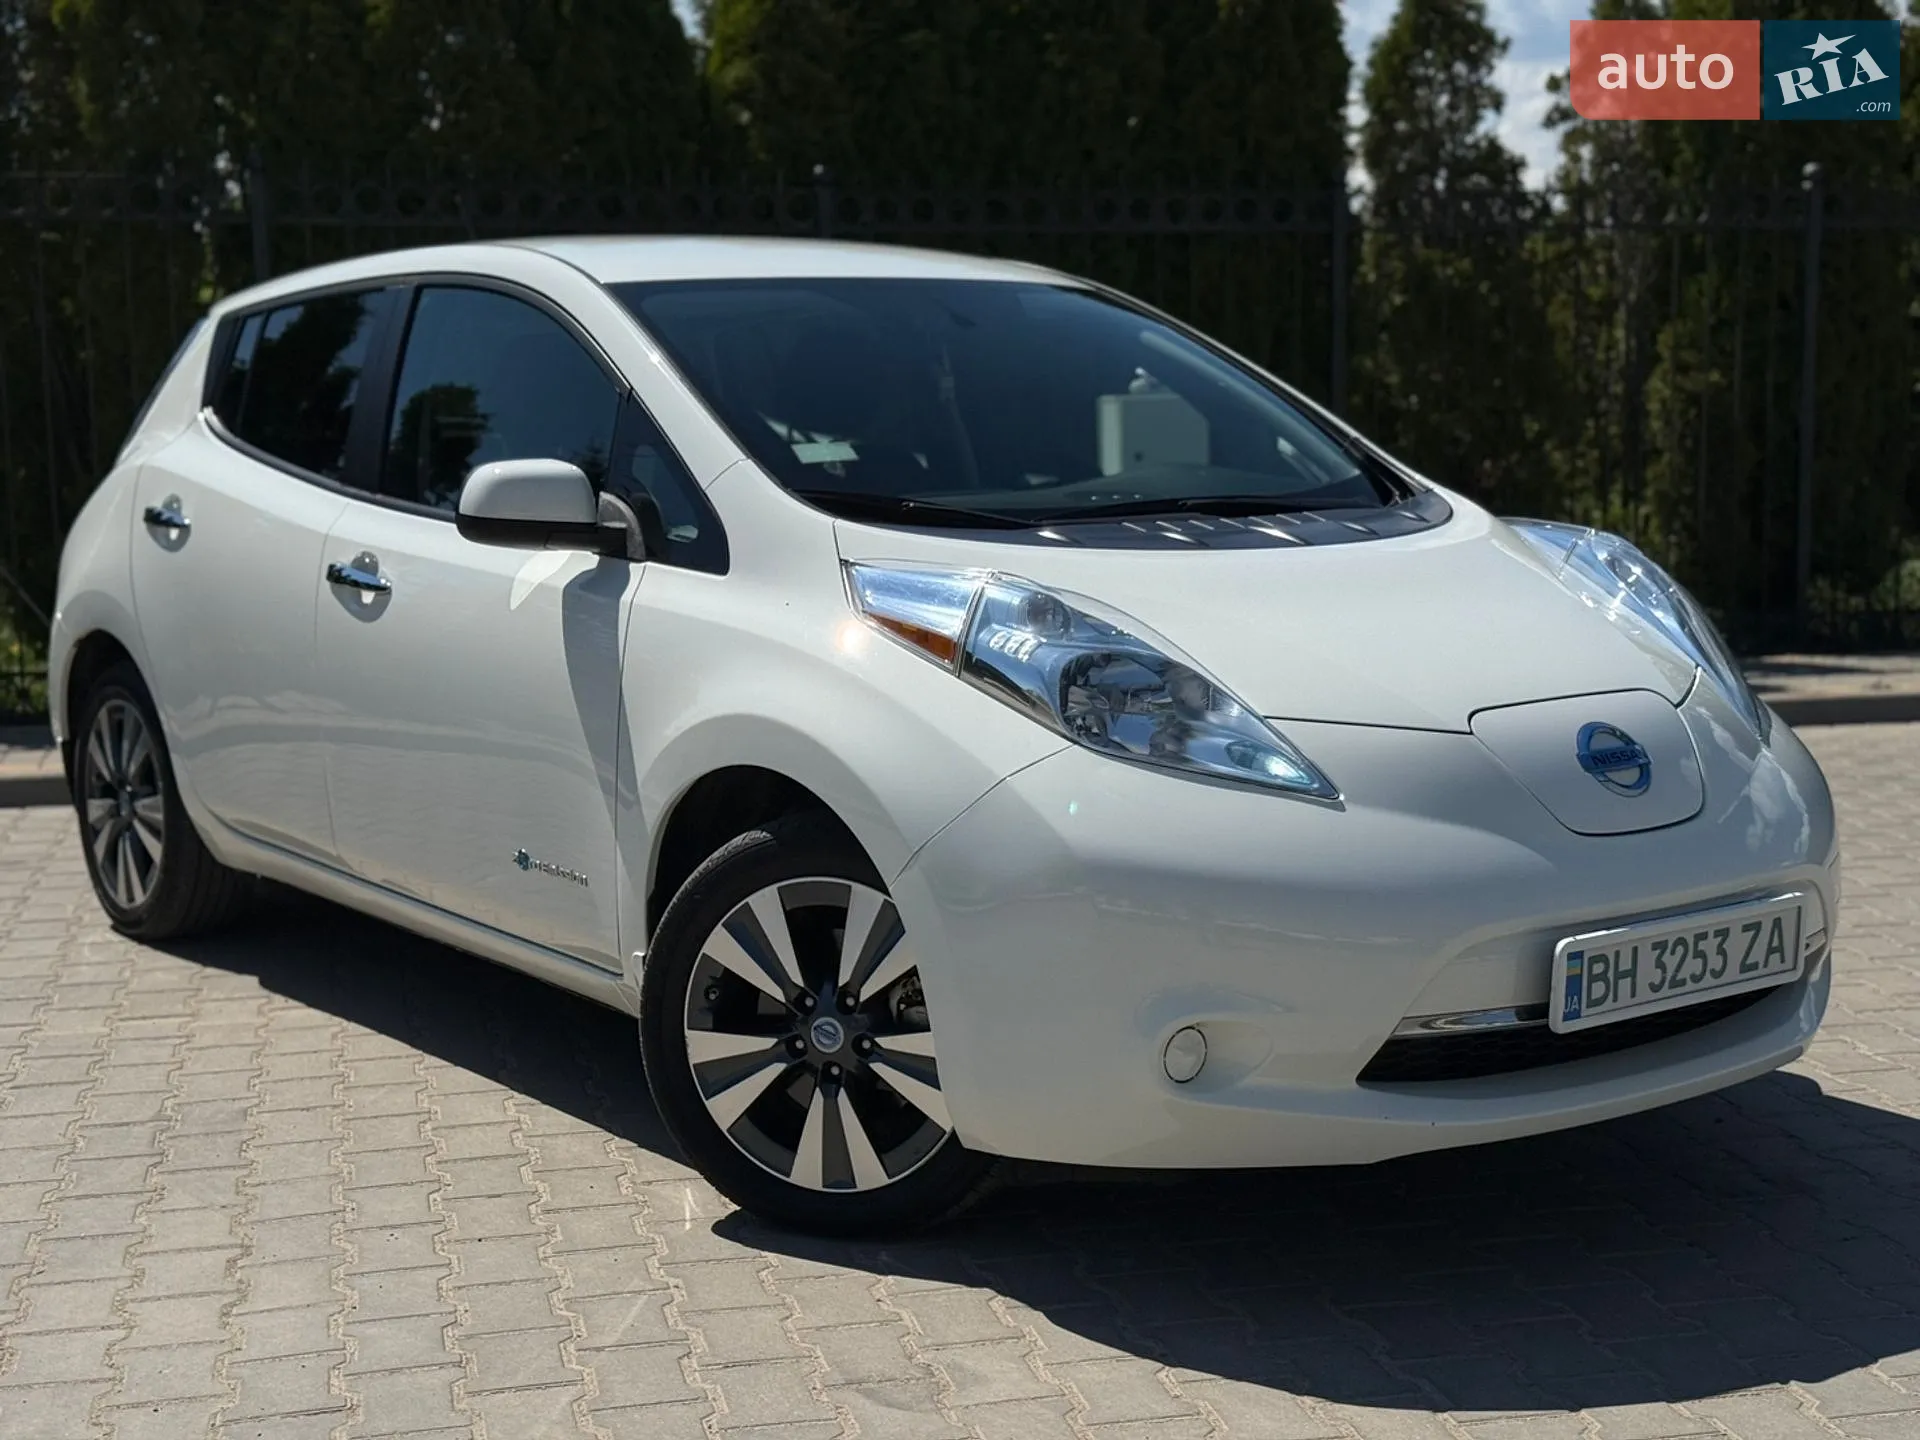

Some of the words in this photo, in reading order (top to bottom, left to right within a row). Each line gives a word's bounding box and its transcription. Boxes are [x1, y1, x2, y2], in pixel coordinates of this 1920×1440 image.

[1586, 945, 1638, 1009] BH
[1648, 928, 1730, 993] 3253
[1738, 917, 1786, 974] ZA
